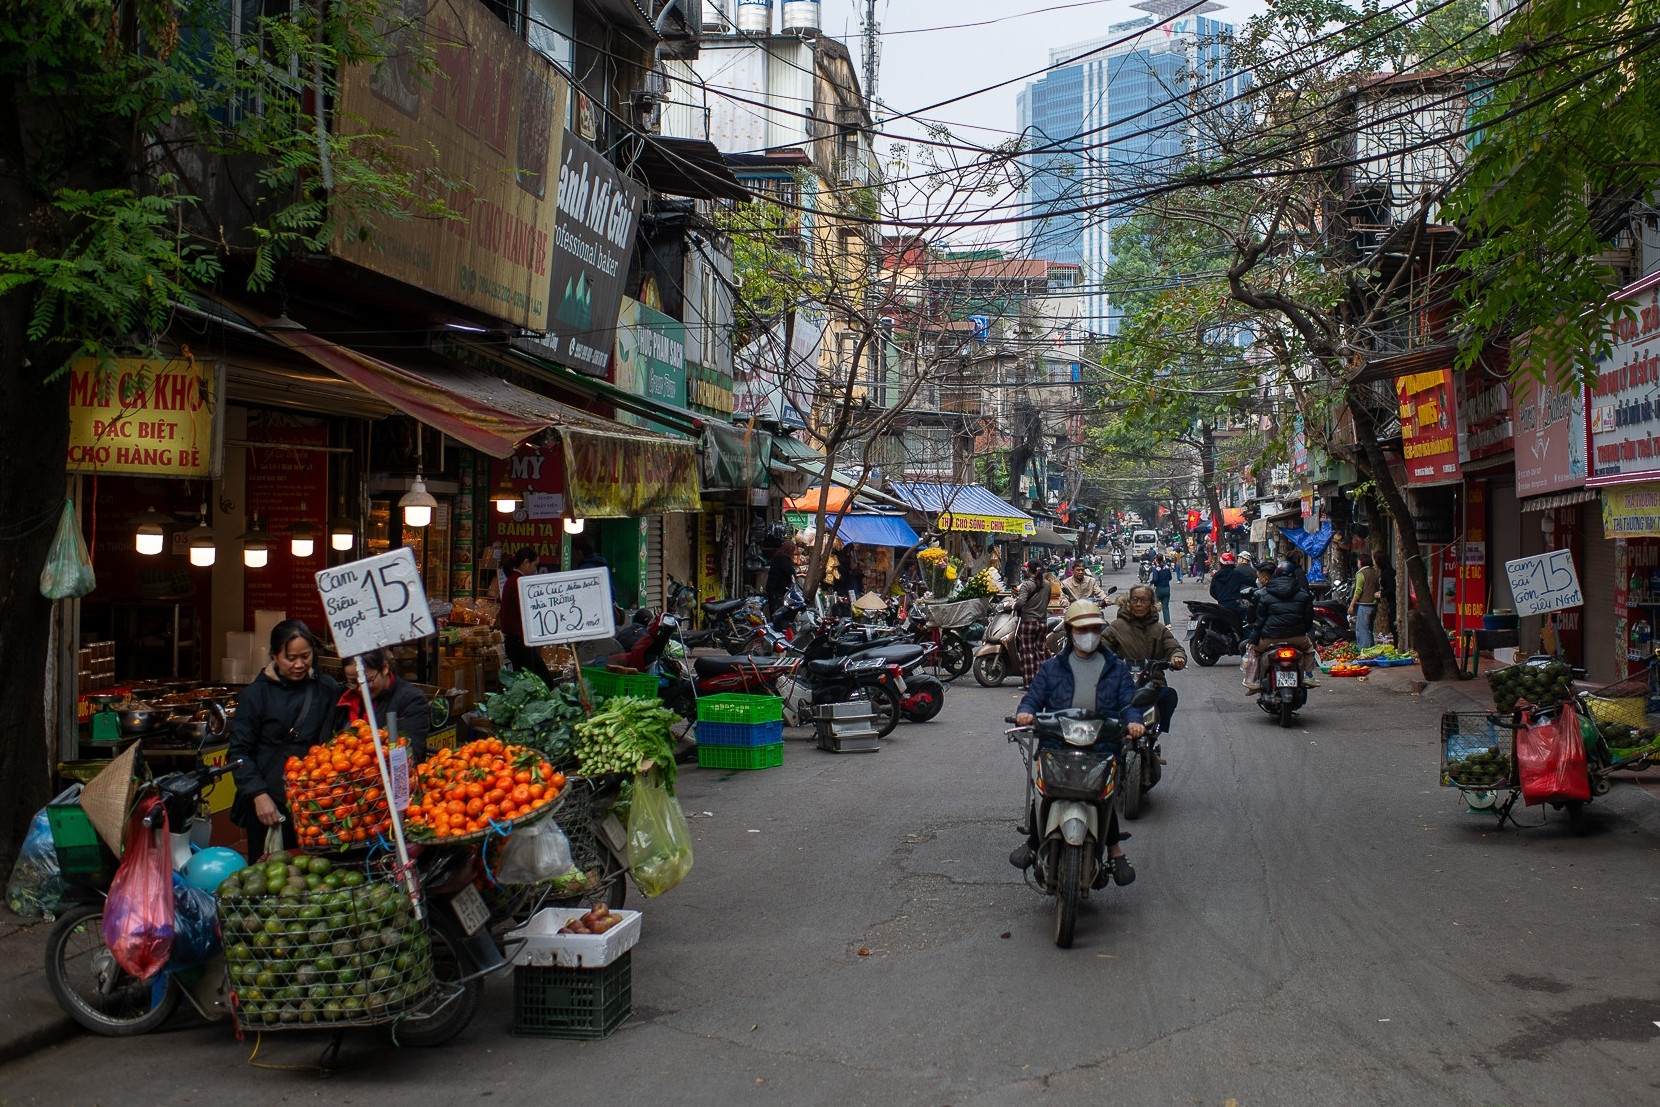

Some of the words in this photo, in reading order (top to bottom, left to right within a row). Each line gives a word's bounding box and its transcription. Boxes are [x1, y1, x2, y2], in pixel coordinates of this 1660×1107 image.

[597, 245, 618, 277] baker
[138, 418, 178, 443] BIỆT
[68, 445, 111, 467] CHỢ
[117, 444, 172, 466] HÀNG
[497, 520, 535, 536] BÁNH
[1531, 551, 1573, 596] 15
[319, 571, 358, 593] Cam
[361, 563, 409, 618] 15
[327, 596, 358, 616] Siêu
[333, 610, 366, 637] ngọt
[1557, 612, 1579, 631] CHAY
